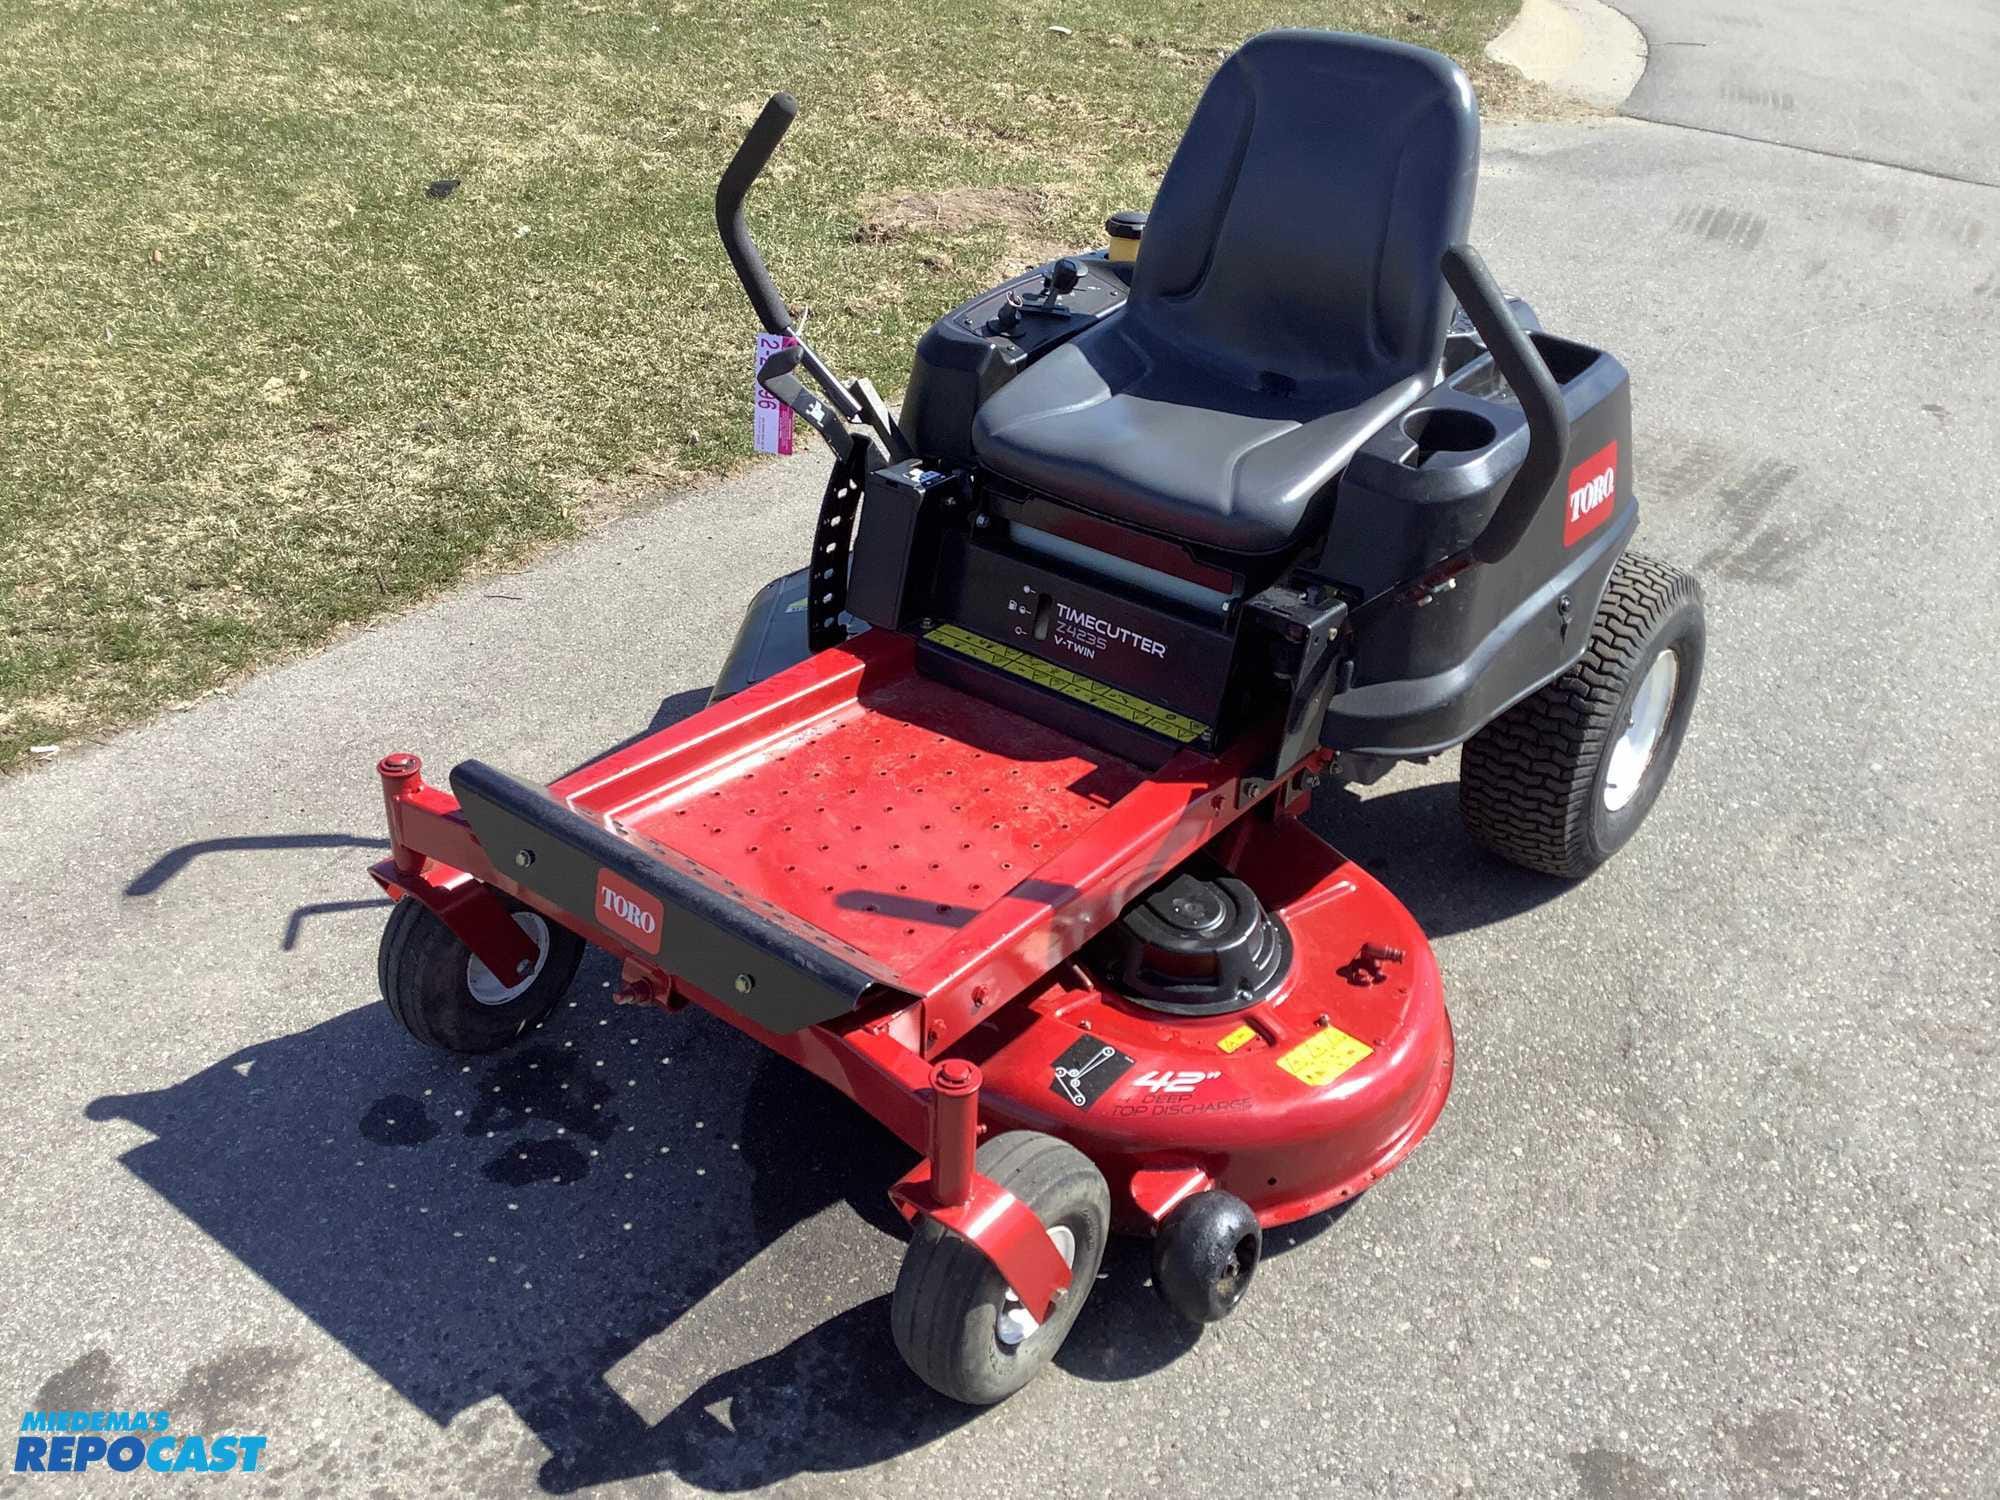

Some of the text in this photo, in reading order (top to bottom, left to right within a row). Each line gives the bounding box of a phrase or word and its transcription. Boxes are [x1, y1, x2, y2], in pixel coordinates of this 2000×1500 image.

[1570, 466, 1615, 523] TORO
[1054, 634, 1096, 659] V-TWIN
[1057, 603, 1167, 659] TIMECUTTER
[601, 886, 656, 934] TORO
[1131, 1070, 1223, 1094] 42"
[1112, 1104, 1149, 1117] TOP
[1152, 1096, 1252, 1116] DISCHARGE
